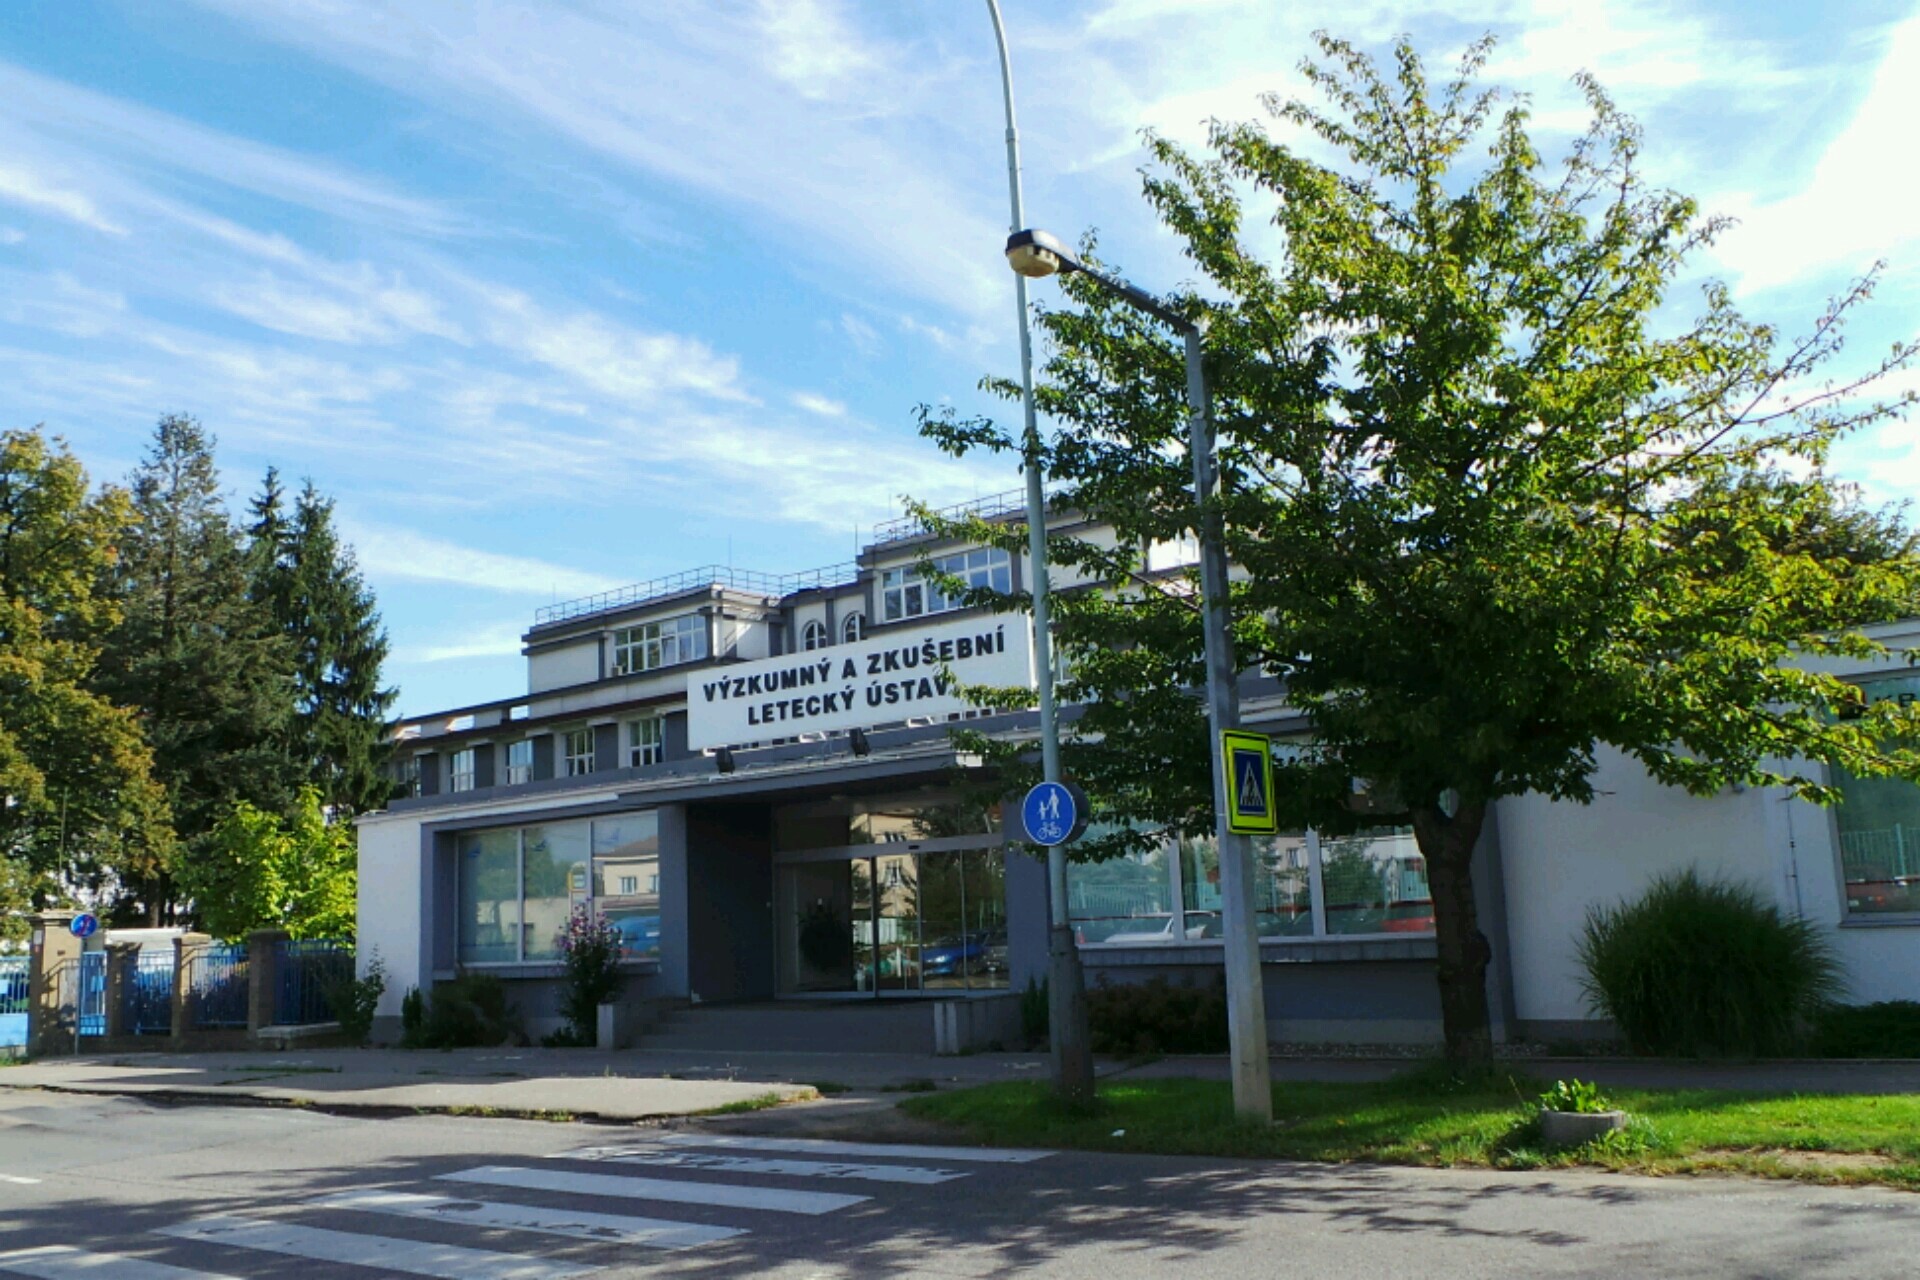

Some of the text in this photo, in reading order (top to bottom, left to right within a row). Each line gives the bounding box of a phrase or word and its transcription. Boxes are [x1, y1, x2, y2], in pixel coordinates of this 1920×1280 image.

[703, 624, 1004, 702] VÝZKUMNÝ A ZKUŠEBNÍ
[748, 680, 949, 725] LETECKÝ ÚSTAV
